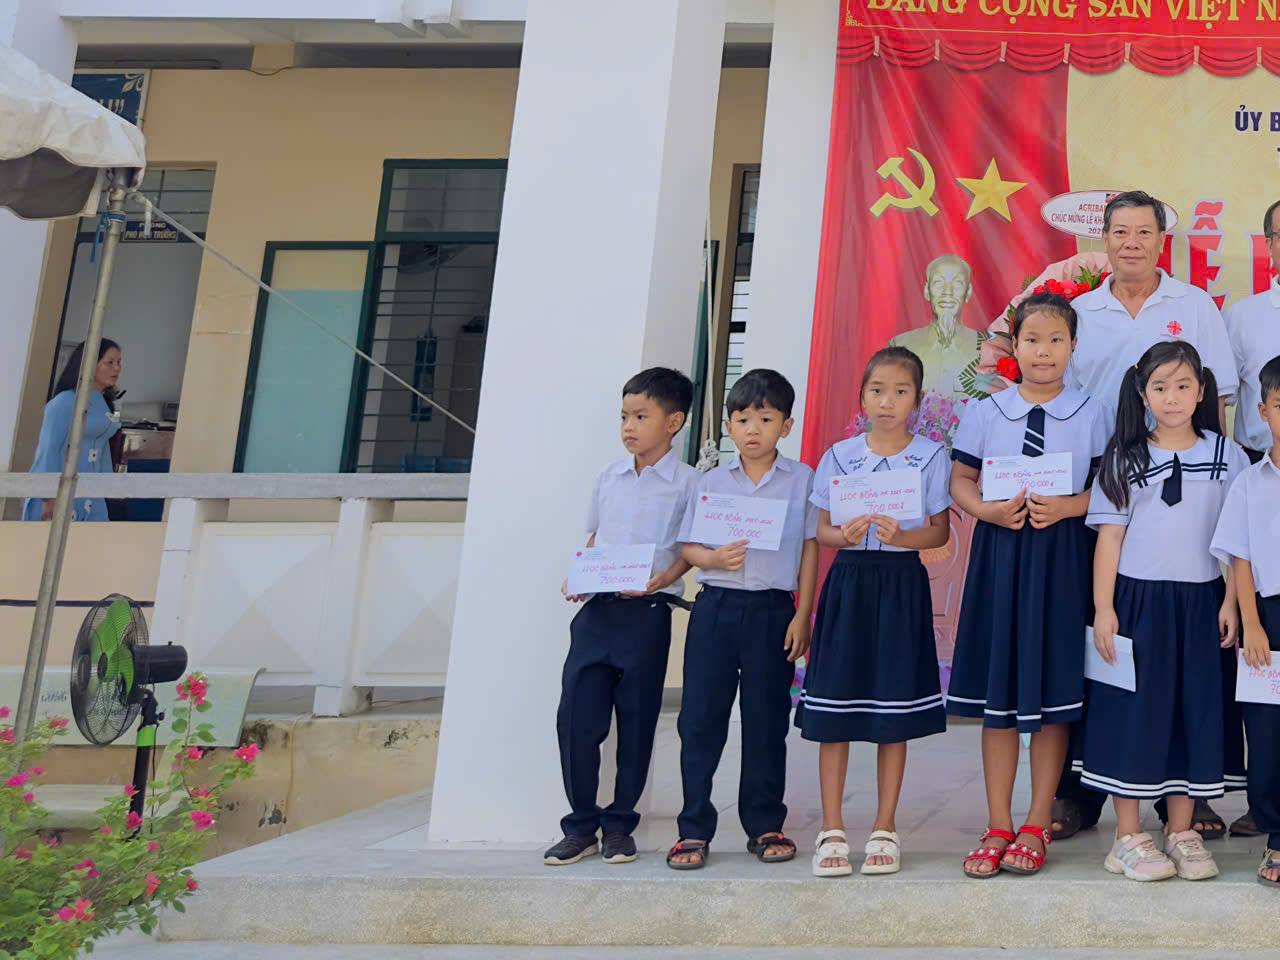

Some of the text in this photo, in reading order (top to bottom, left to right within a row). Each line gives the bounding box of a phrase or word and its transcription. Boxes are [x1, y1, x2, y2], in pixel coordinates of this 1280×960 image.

[1234, 105, 1263, 132] ỦY
[1078, 203, 1105, 212] AGRIBA
[1088, 227, 1104, 235] 202
